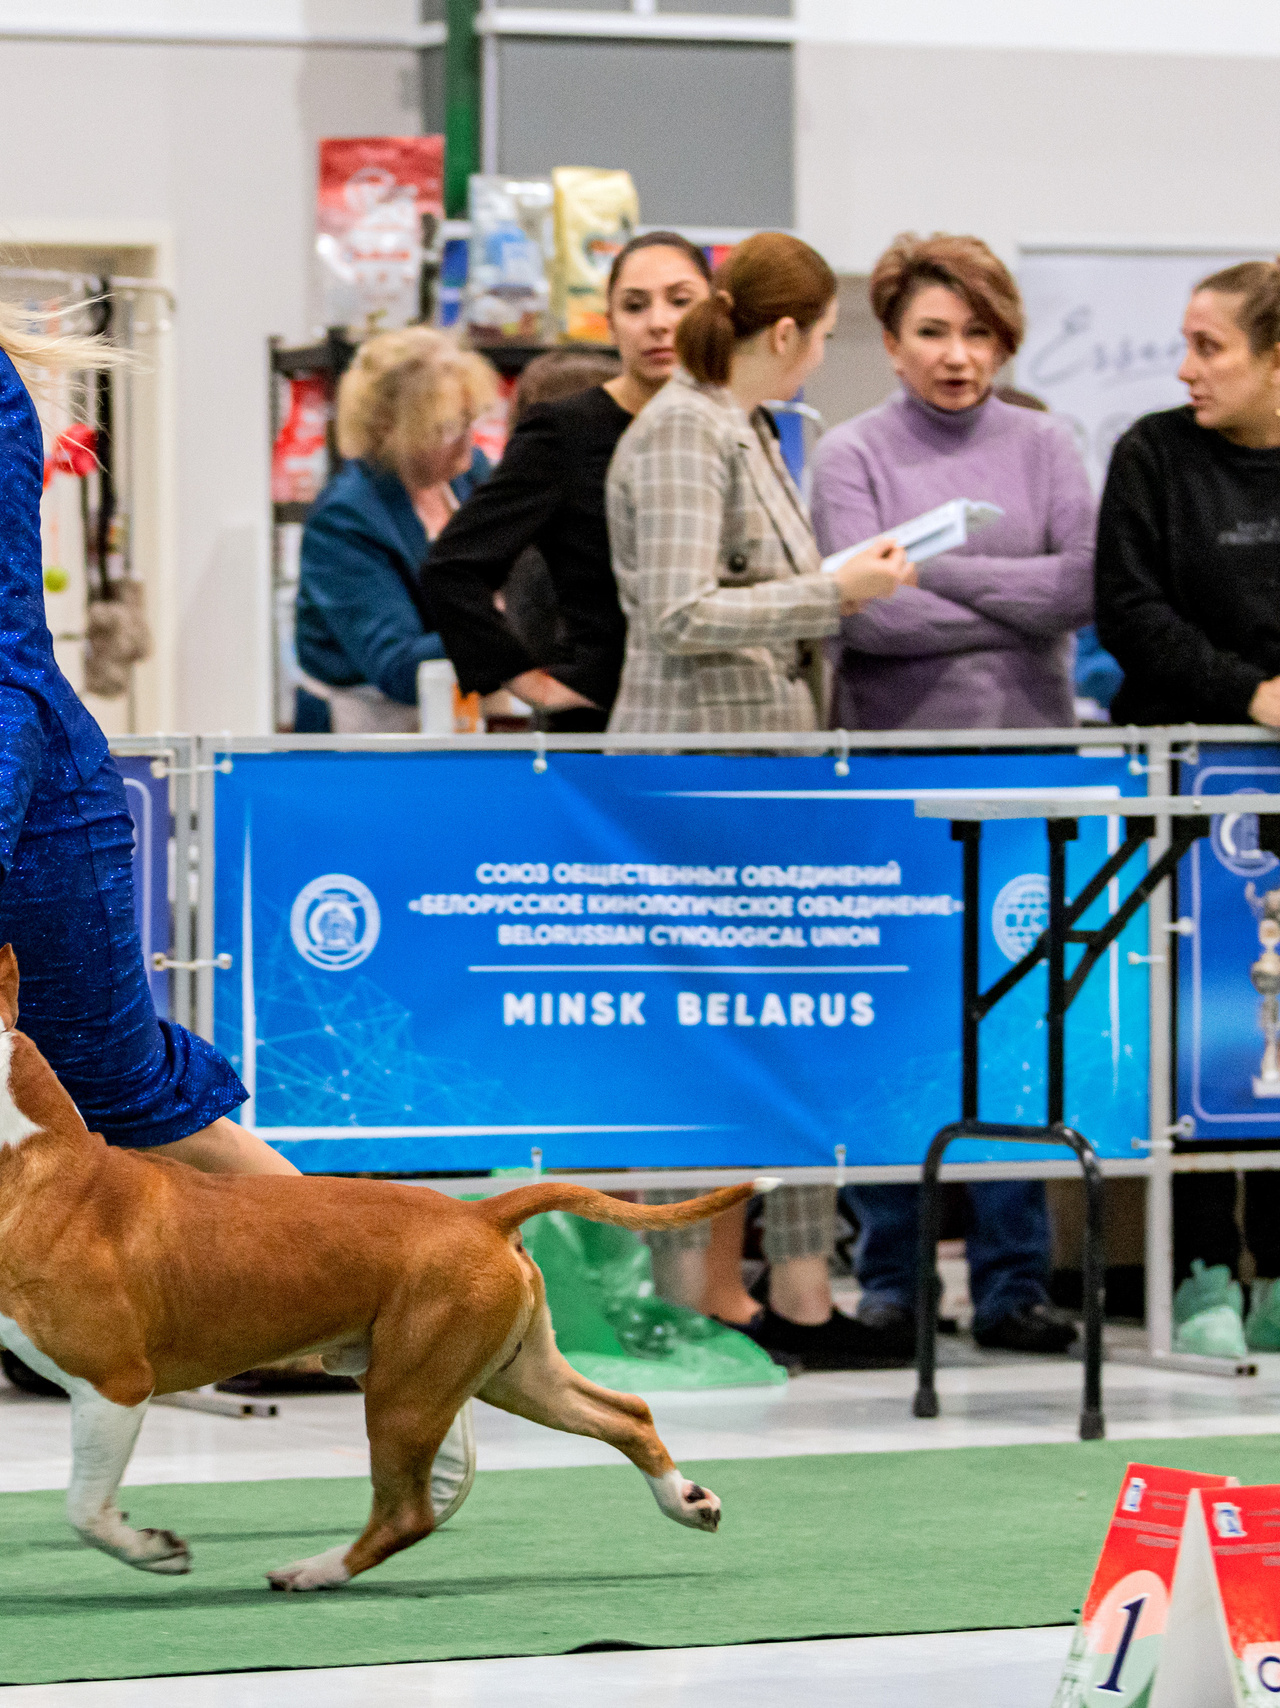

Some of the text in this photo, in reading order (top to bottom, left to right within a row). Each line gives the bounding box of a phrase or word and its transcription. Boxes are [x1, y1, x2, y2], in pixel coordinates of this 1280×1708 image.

[476, 863, 549, 884] СОЮЗ
[497, 924, 880, 947] BELORUSSIAN CYNOLOGICAL UNION
[503, 991, 875, 1027] MINSK BELARUS
[1095, 1595, 1148, 1693] 1
